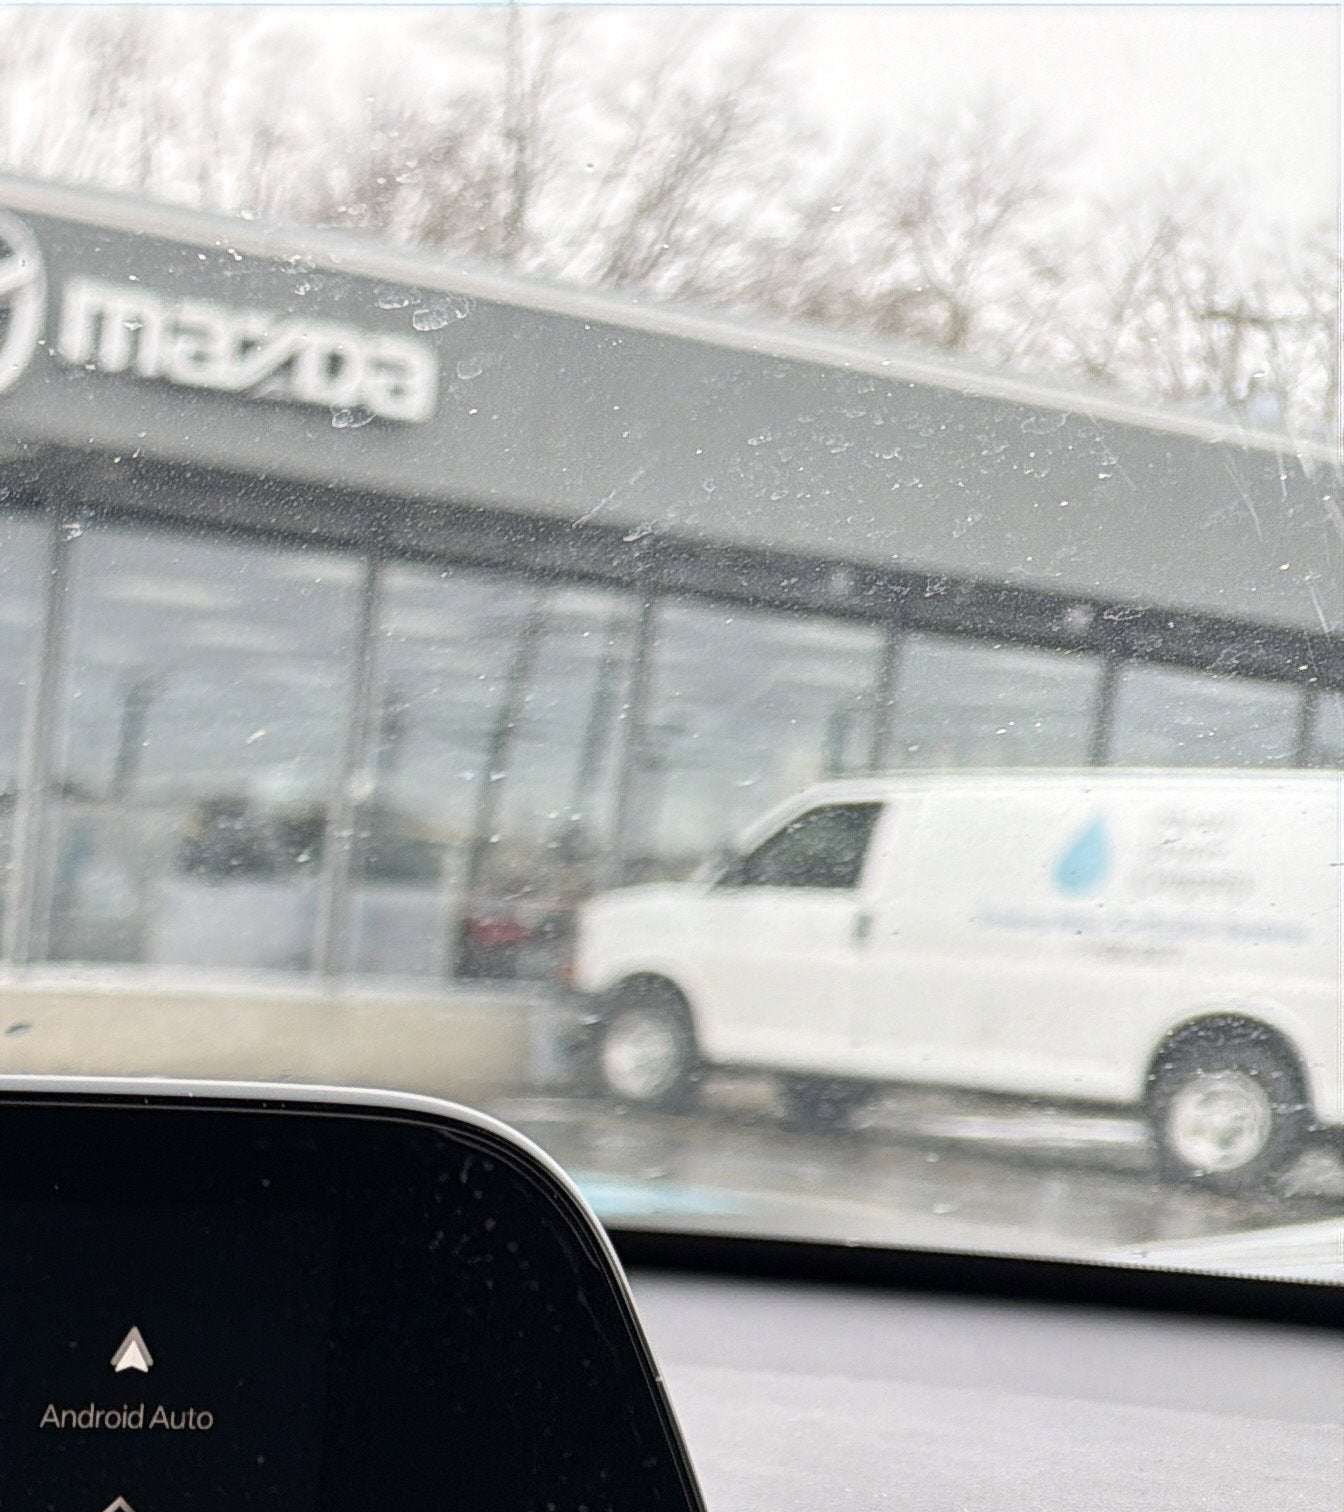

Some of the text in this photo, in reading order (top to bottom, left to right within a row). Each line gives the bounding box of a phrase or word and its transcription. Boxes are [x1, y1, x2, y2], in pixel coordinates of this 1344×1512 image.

[58, 276, 438, 423] mazda
[39, 1402, 214, 1430] Android Auto
